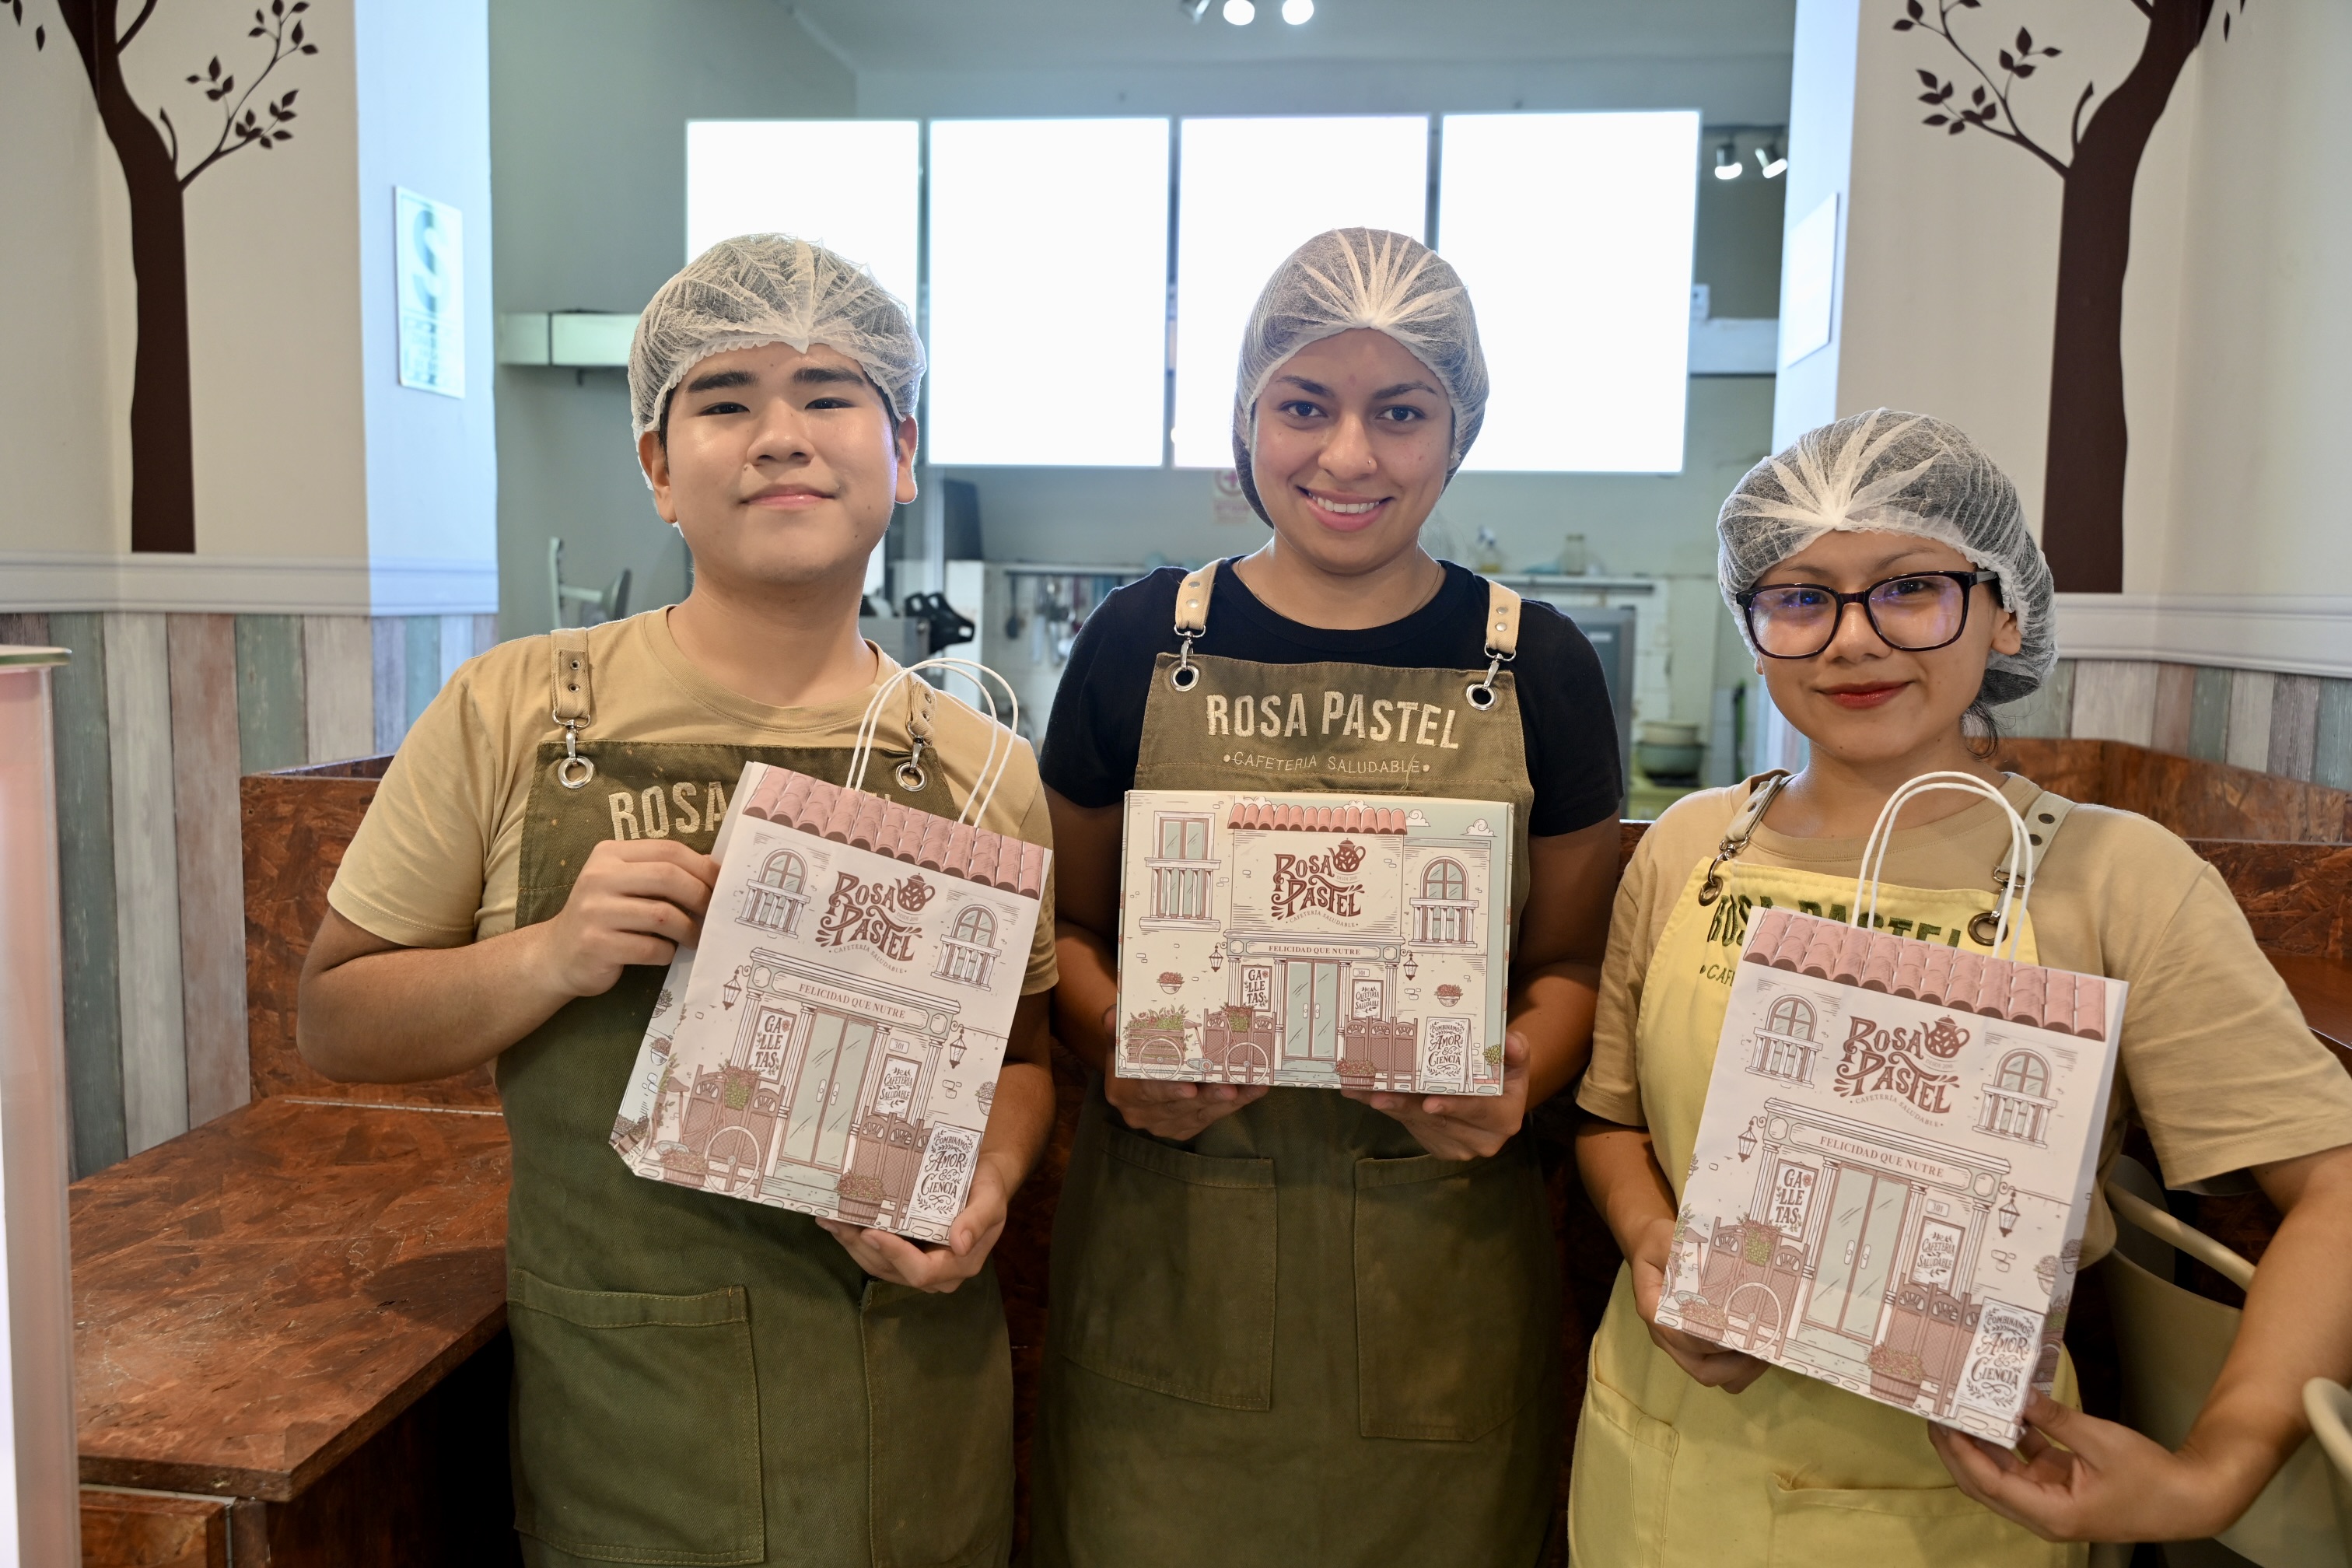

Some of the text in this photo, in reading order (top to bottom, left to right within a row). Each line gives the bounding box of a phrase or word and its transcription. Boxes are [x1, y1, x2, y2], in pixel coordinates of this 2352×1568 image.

[1206, 691, 1458, 749] ROSA PASTEL
[1234, 751, 1419, 774] CAFETERIA SALUDABLE
[608, 782, 727, 841] ROSA
[1273, 854, 1335, 891] ROSA
[825, 871, 897, 916] ROSA
[1271, 875, 1361, 918] PASTEL
[1323, 914, 1355, 927] SALUDABLE
[821, 903, 915, 961] PASTEL
[870, 950, 903, 973] SALUDABLE
[1248, 969, 1262, 981] GA
[1248, 981, 1265, 992] LLE
[799, 983, 906, 1019] FELICIDAD QUE NUTRE
[1247, 992, 1264, 1003] TAS
[1355, 1000, 1379, 1010] SALUDABLE
[765, 1015, 782, 1034] GA
[1432, 1025, 1462, 1034] COMBINAMOS
[759, 1034, 783, 1050] LLE
[894, 1041, 905, 1050] 301
[1428, 1034, 1463, 1052] AMOR
[1840, 1015, 1923, 1064] ROSA
[754, 1052, 777, 1068] TAS
[1428, 1051, 1461, 1066] CIENCIA
[1836, 1049, 1951, 1114] PASTEL
[880, 1088, 910, 1100] SALUDABLE
[1899, 1101, 1939, 1127] SALUDABLE
[935, 1136, 971, 1153] COMBINAMOS
[925, 1151, 967, 1173] AMOR
[1819, 1136, 1944, 1178] FELICIDAD QUE NUTRE
[921, 1173, 957, 1199] CIENCIA
[1783, 1168, 1803, 1188] GA
[1780, 1188, 1804, 1206] LLE
[1775, 1206, 1799, 1224] TAS
[1932, 1203, 1943, 1213] 301
[1917, 1255, 1953, 1269] SALUDABLE
[1987, 1315, 2031, 1338] COMBINAMOS
[1976, 1332, 2028, 1361] AMOR
[1971, 1356, 2018, 1391] CIENCIA
